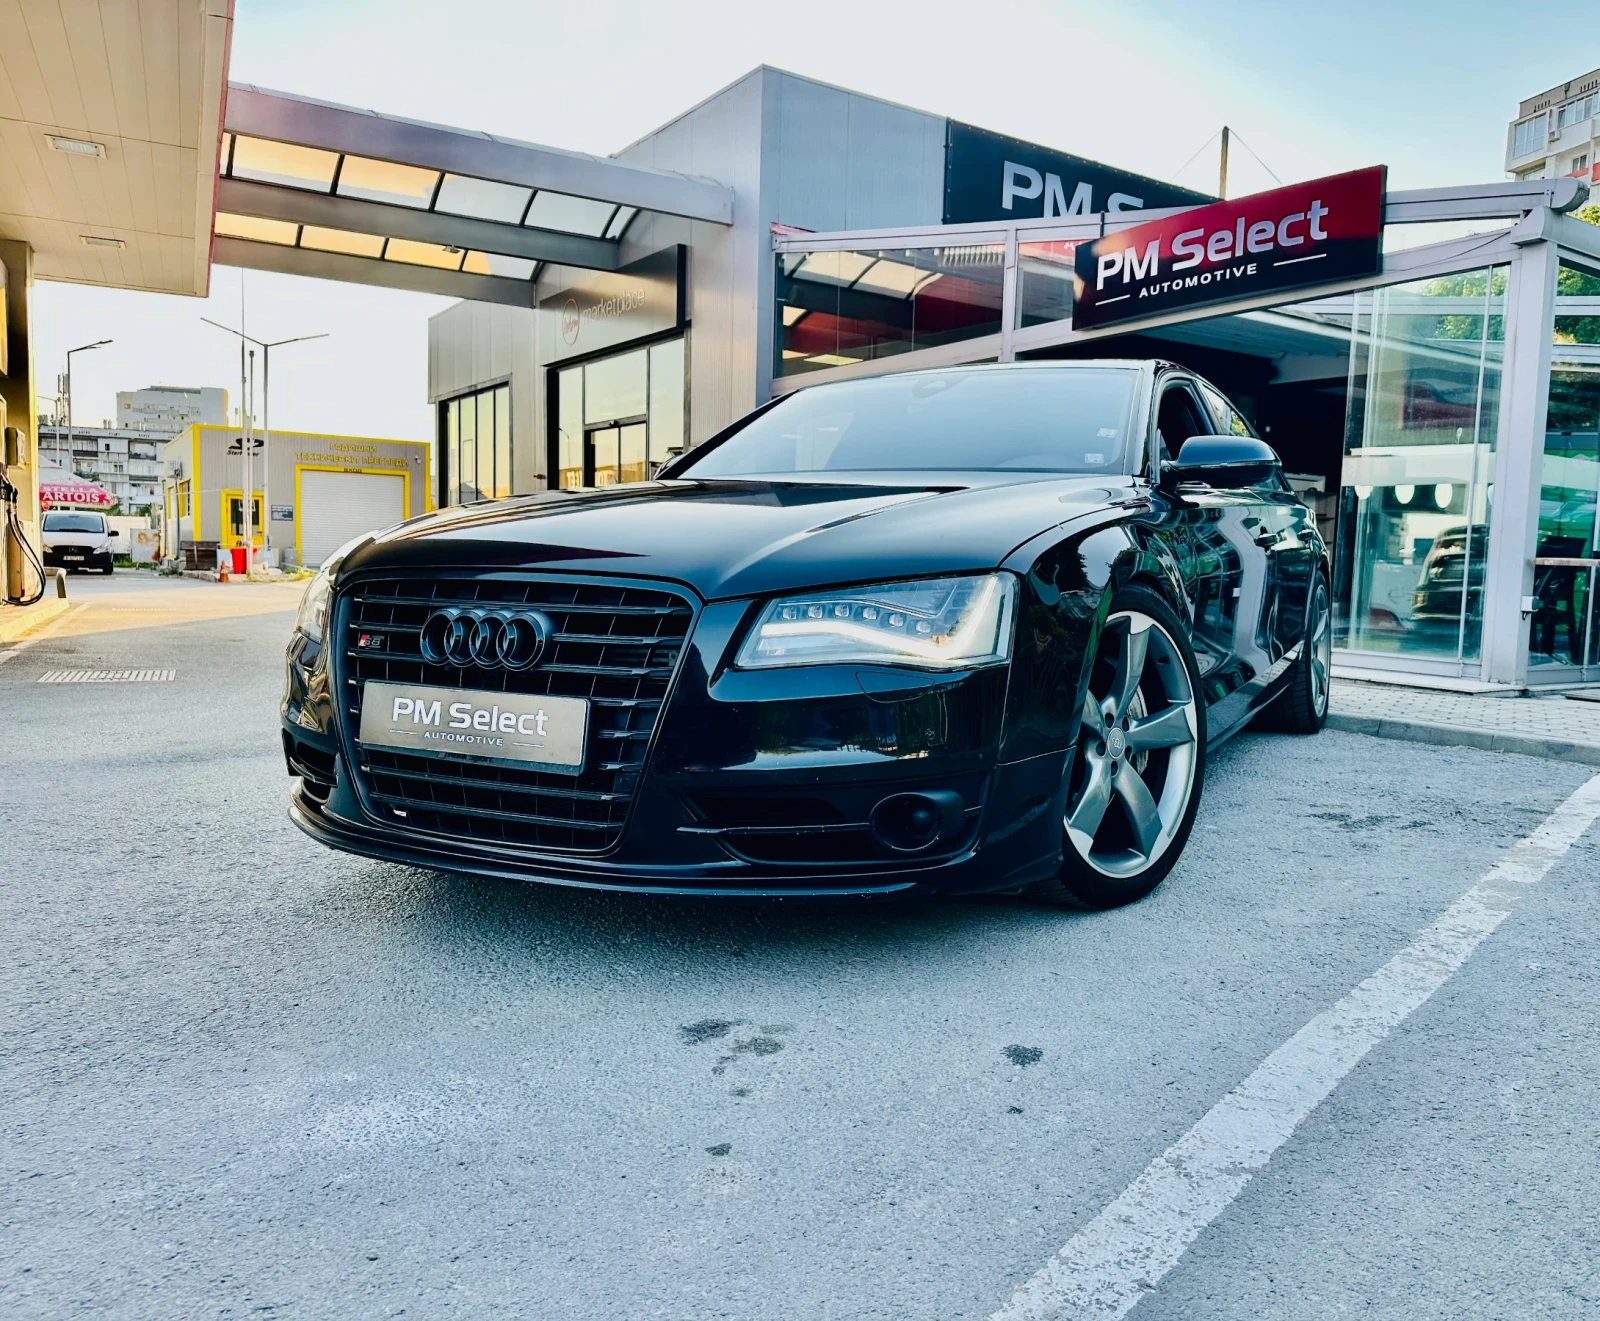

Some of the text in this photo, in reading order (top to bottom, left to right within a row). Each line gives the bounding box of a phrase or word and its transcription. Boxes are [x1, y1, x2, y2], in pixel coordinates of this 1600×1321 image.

[1002, 160, 1093, 218] PM
[1096, 199, 1329, 291] PM Select
[1138, 263, 1258, 299] AUTOMOTIVE
[582, 288, 646, 325] marketplace
[295, 452, 359, 464] ТЕХНИЧЕСКИ
[329, 443, 377, 453] ГОДИШНИ
[43, 491, 100, 503] ARTOIS
[392, 697, 548, 737] PM Select
[424, 731, 504, 747] AUTOMOTIVE
